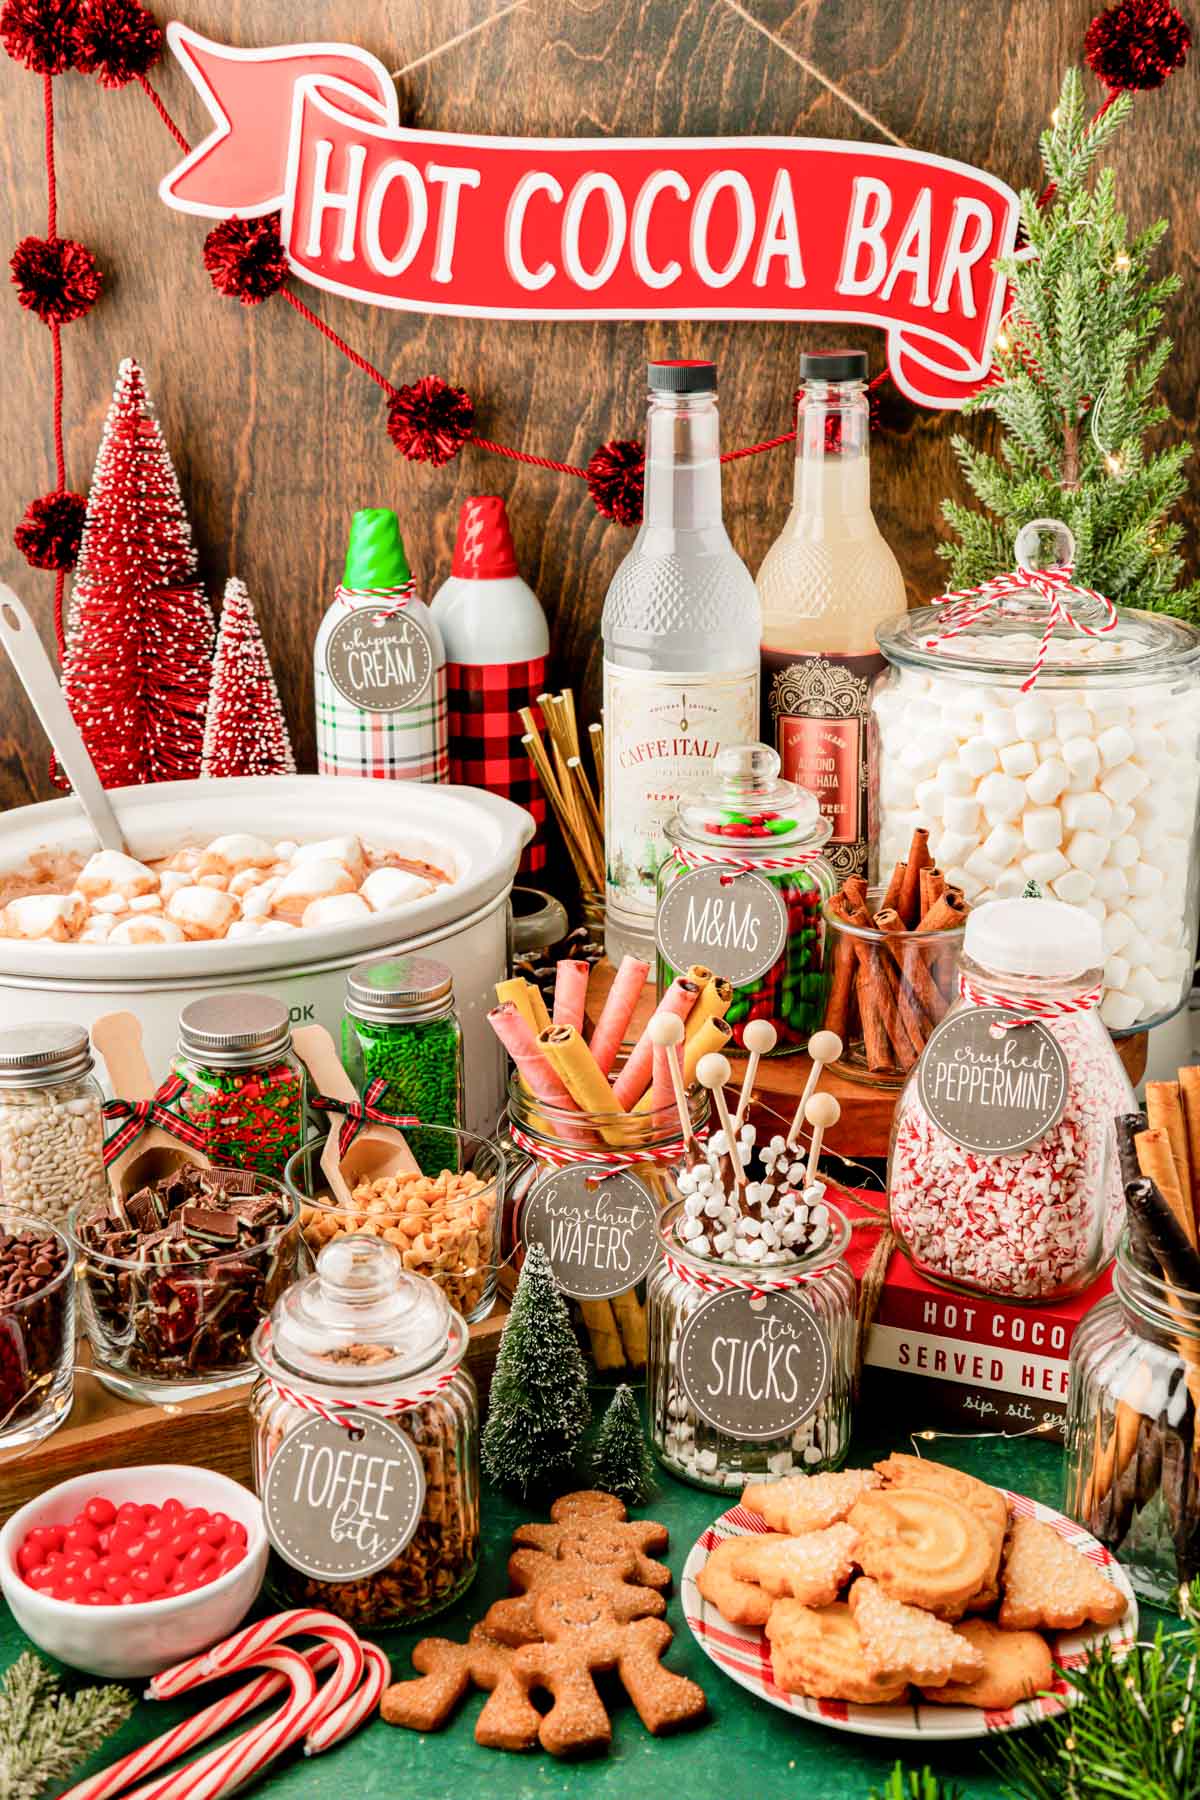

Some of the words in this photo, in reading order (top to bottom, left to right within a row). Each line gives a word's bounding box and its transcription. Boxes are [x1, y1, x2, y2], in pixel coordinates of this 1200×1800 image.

[306, 139, 481, 283] HOT
[505, 168, 806, 290] COCOA
[835, 176, 993, 318] BAR
[342, 622, 415, 654] whipped
[348, 642, 416, 690] CREAM
[683, 895, 761, 952] M&Ms
[954, 1039, 1053, 1071] crushed
[935, 1062, 1052, 1111] PEPPERMINT
[545, 1190, 646, 1230] hazelnut
[550, 1218, 634, 1272] WAFERS
[754, 1314, 803, 1341] stir
[923, 1301, 977, 1332] HOT
[706, 1336, 801, 1402] STICKS
[898, 1343, 1004, 1382] SERVED
[294, 1444, 401, 1520] TOFFEE
[331, 1499, 386, 1555] bits
